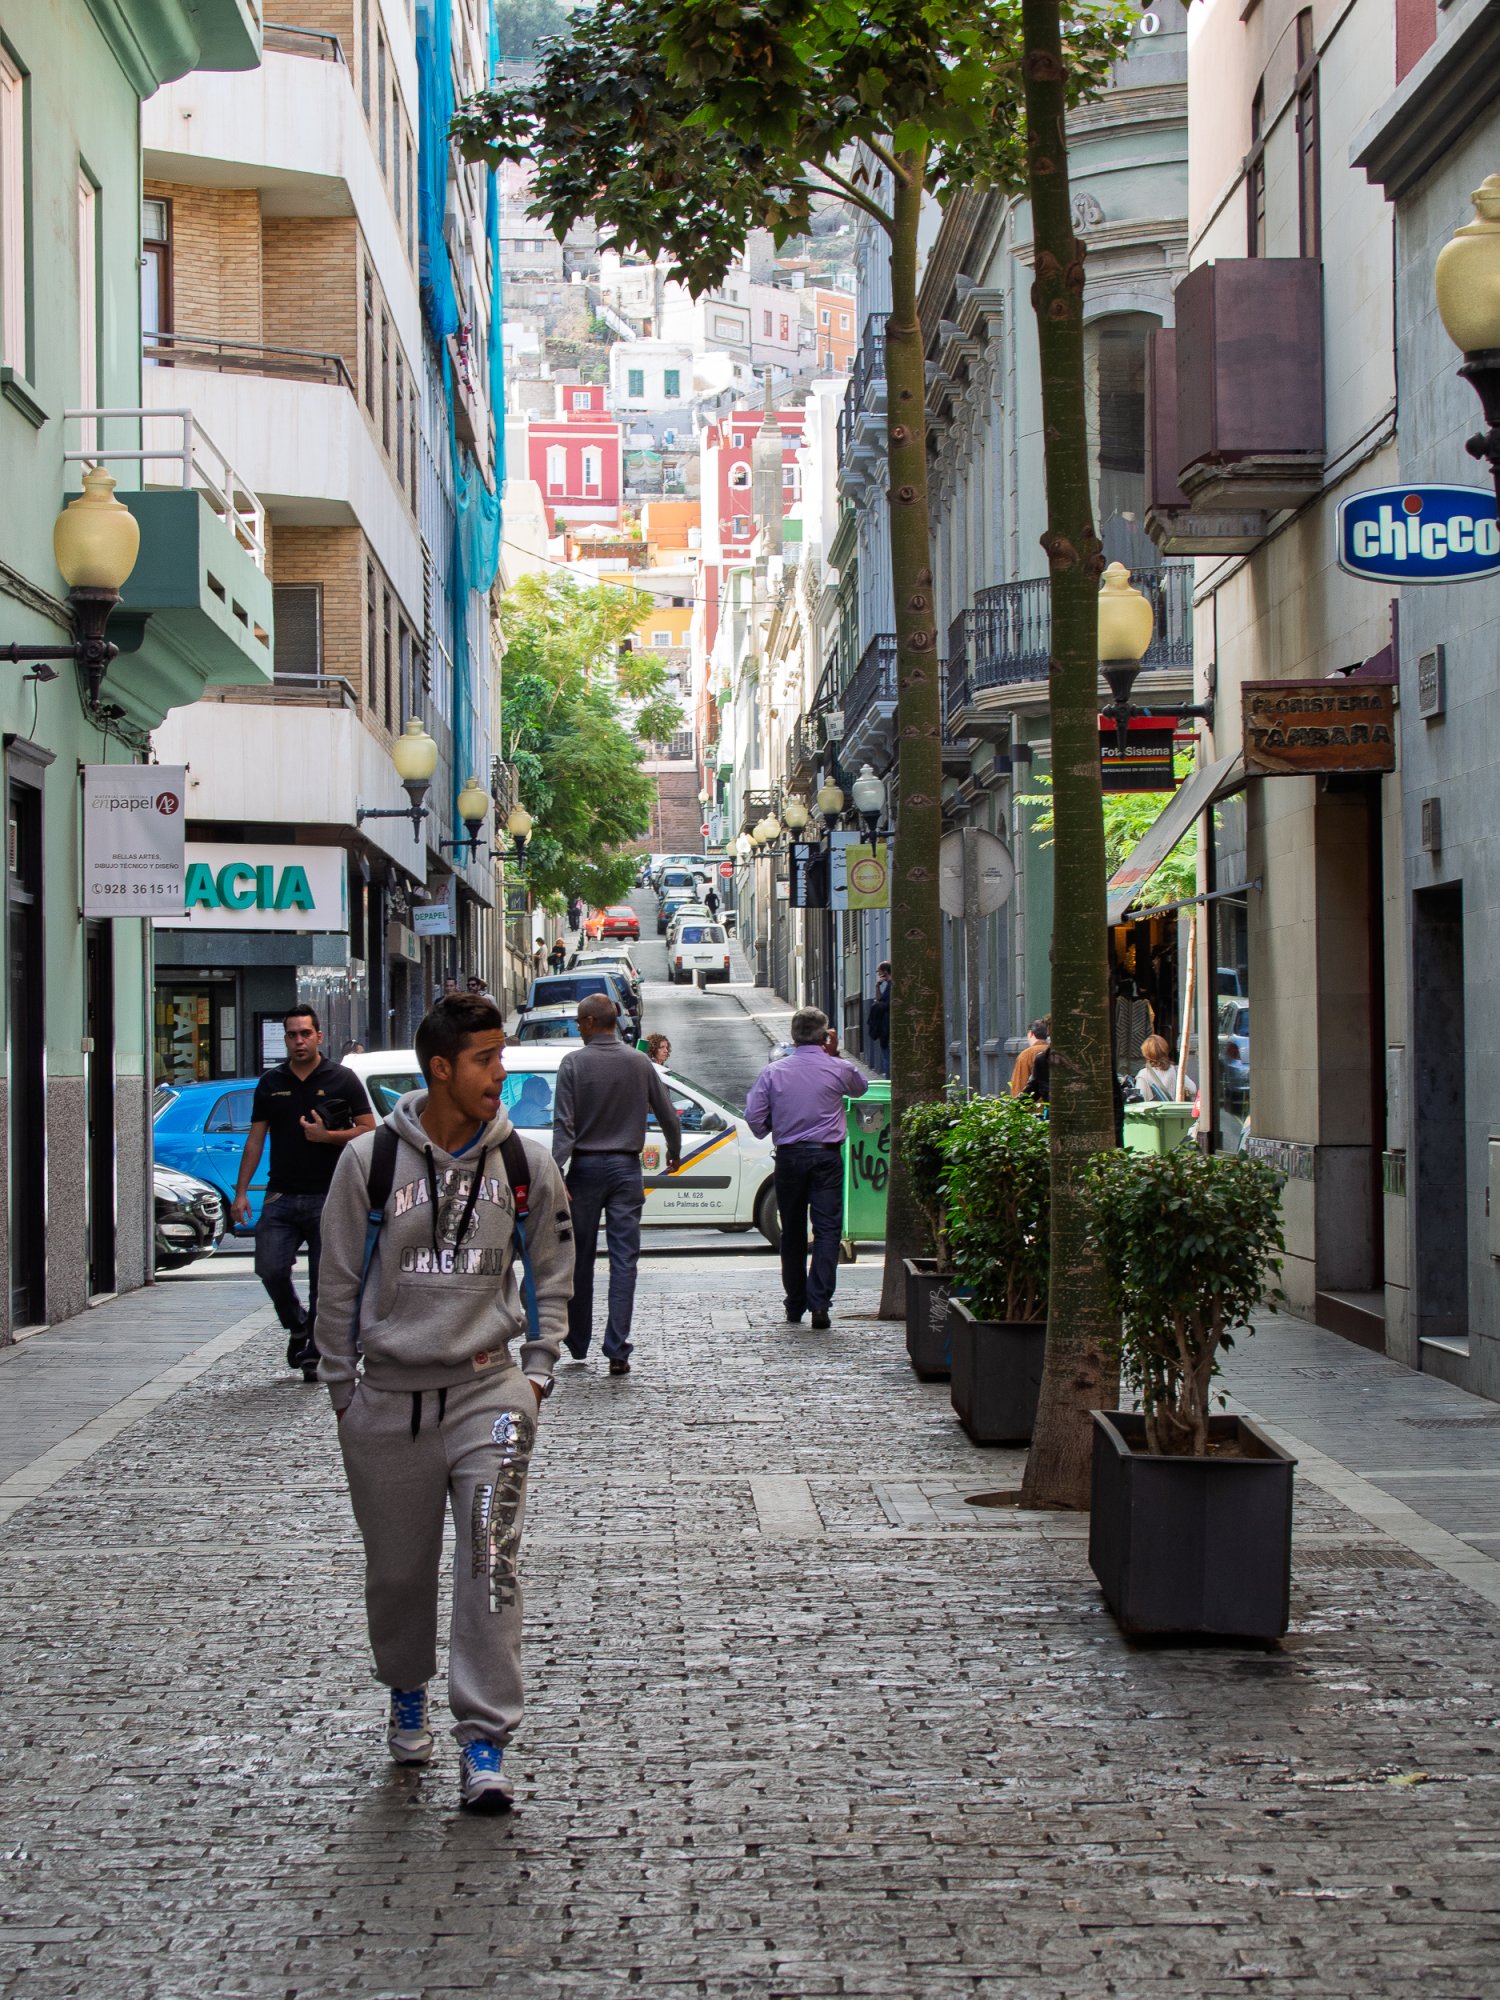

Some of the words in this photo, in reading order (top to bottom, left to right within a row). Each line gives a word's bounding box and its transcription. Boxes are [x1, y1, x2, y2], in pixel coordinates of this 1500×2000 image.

[1353, 494, 1499, 560] chicco
[104, 884, 127, 894] 928
[132, 884, 147, 894] 36
[150, 884, 164, 894] 15
[167, 884, 180, 894] 11
